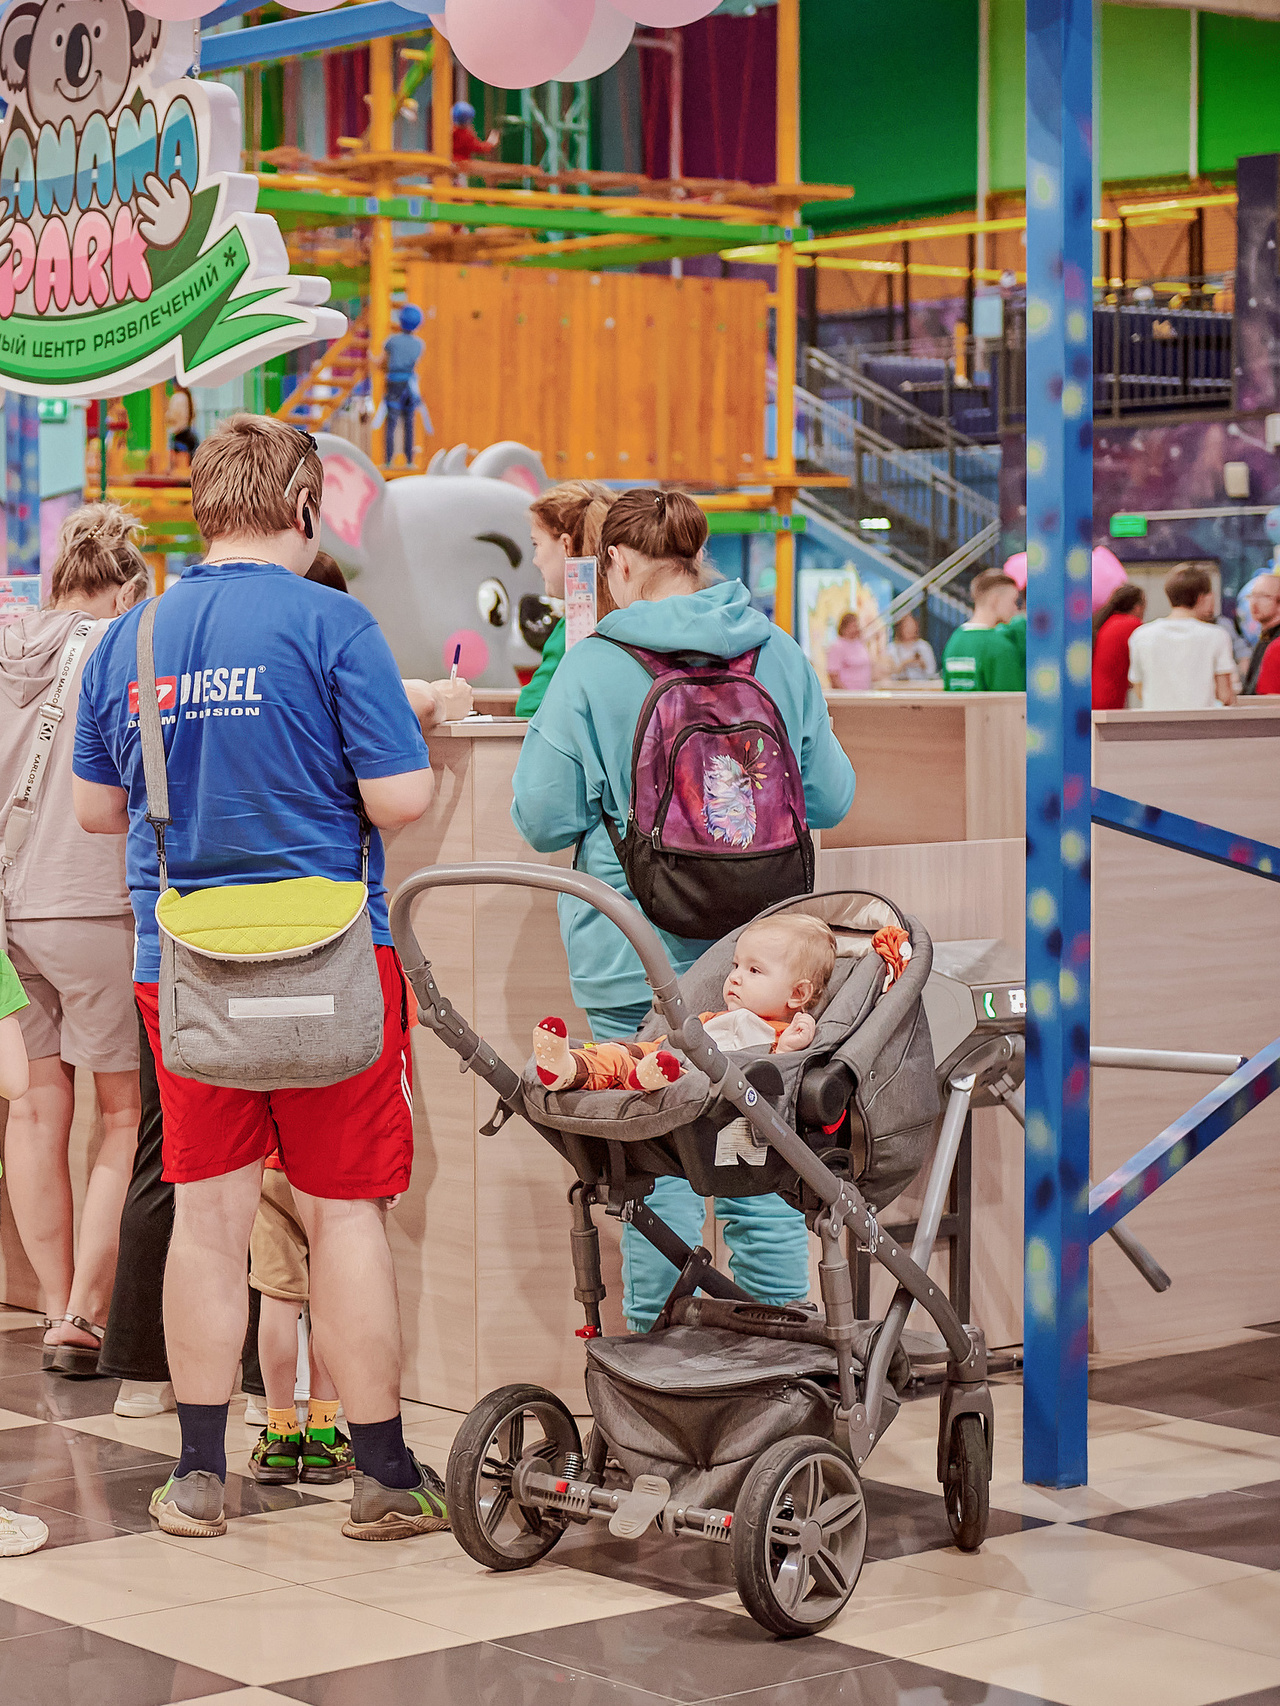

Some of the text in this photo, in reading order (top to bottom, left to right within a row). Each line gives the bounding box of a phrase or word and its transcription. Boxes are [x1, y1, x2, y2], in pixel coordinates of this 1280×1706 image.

[32, 338, 86, 358] ЦЕНТР
[93, 263, 219, 351] РАЗВЛЕЧЕНИЙ
[52, 646, 77, 704] KARLOS MARCO
[180, 667, 263, 705] DIESEL
[23, 753, 41, 802] KARLOS MAR
